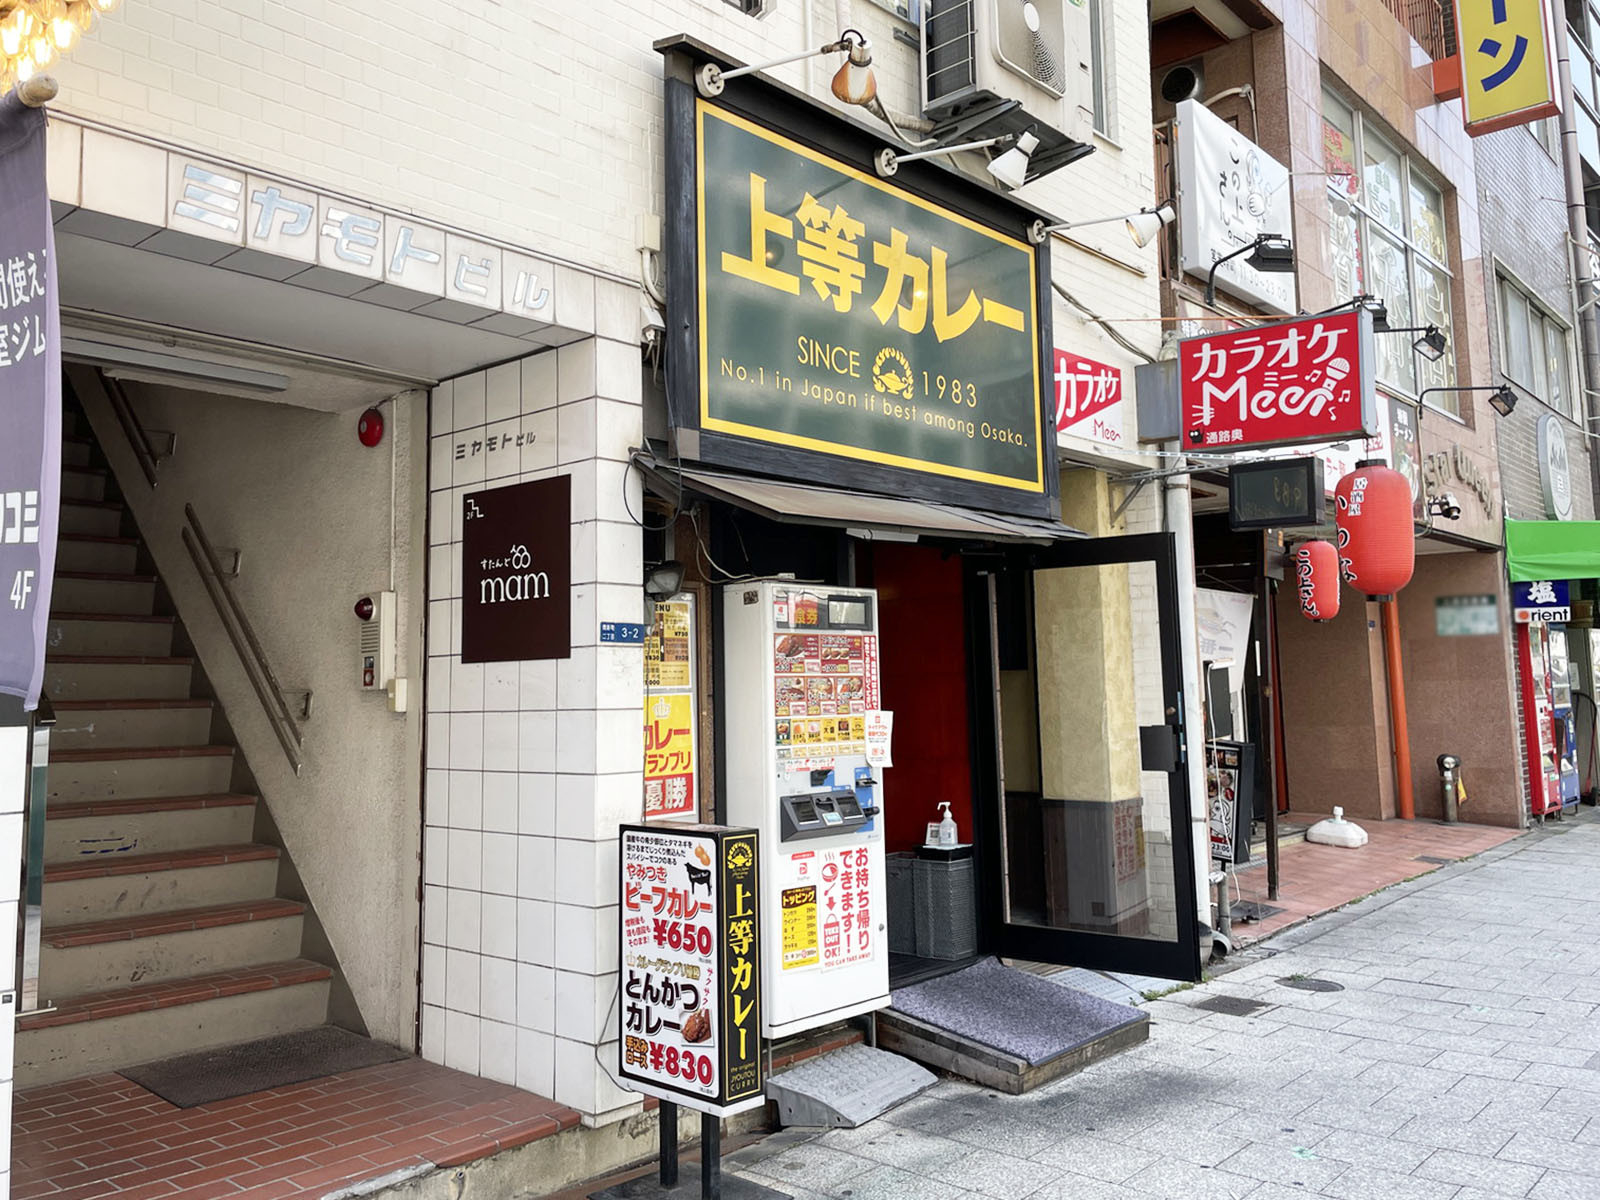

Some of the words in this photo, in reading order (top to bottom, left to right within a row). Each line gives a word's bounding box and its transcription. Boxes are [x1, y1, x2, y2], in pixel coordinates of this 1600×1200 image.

[174, 163, 550, 310] ミヤモトビル
[721, 172, 1025, 343] 上等カレー
[797, 335, 861, 378] SINCE
[1190, 323, 1349, 382] カラオケ
[921, 371, 978, 408] 1983
[1054, 357, 1120, 426] カラオケ
[1263, 371, 1298, 387] ミー
[720, 357, 765, 386] No.1
[775, 371, 792, 392] in
[801, 378, 857, 408] Japan
[864, 393, 876, 412] if
[883, 400, 918, 421] best
[923, 409, 975, 439] among
[980, 422, 1029, 447] Osaka.
[455, 432, 536, 460] ミヤモトビル
[481, 557, 512, 570] すたんど
[10, 570, 35, 610] 4F
[480, 571, 550, 604] mam
[655, 603, 671, 613] ENU
[621, 626, 639, 639] 3-2
[645, 751, 692, 773] ランプリ
[625, 863, 667, 883] やみつき
[625, 881, 713, 920] ビーフカレー
[782, 890, 815, 906] トッピング
[855, 847, 870, 951] お持ち帰り
[652, 917, 713, 957] ¥650
[824, 948, 840, 959] OK!
[637, 955, 700, 981] カレーグランプリ
[728, 884, 755, 1060] 上等カレー
[625, 970, 700, 1012] とんかつ
[625, 1002, 681, 1035] カレー
[649, 1041, 713, 1086] ¥830
